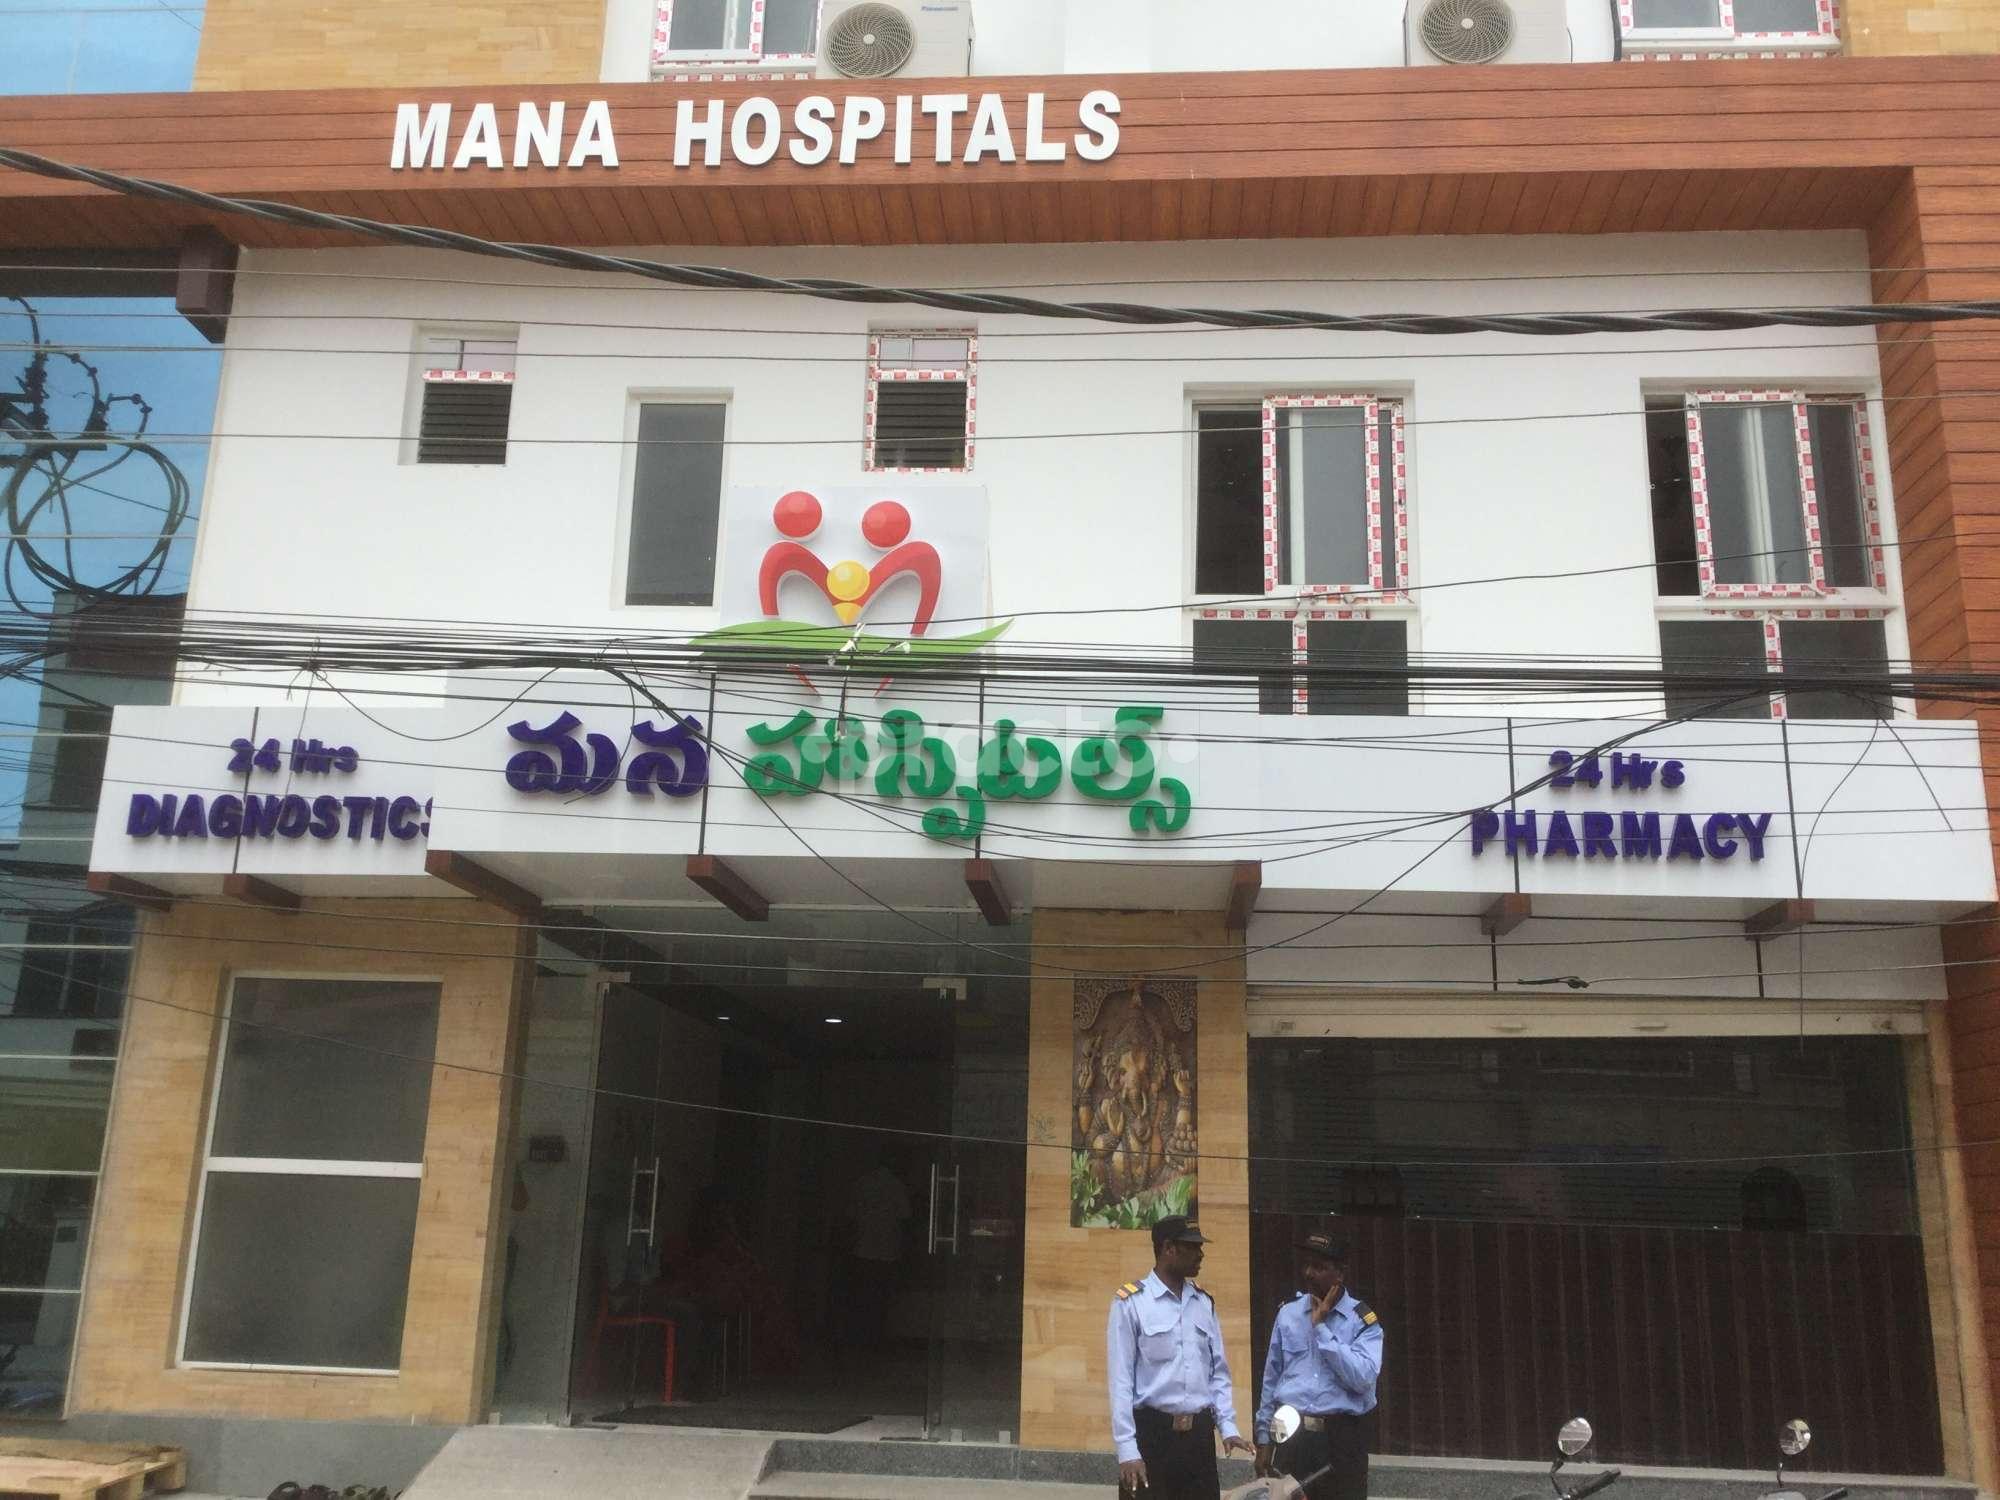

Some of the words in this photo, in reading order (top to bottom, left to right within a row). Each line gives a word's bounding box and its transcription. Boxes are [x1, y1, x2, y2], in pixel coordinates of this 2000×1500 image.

[390, 100, 619, 170] MANA
[673, 90, 1121, 167] HOSPITALS
[227, 737, 281, 774] 24
[289, 738, 360, 775] Hrs
[505, 710, 710, 797] మన
[1548, 750, 1603, 789] 24
[1610, 751, 1685, 790] Hrs
[1471, 808, 1772, 862] PHARMACY
